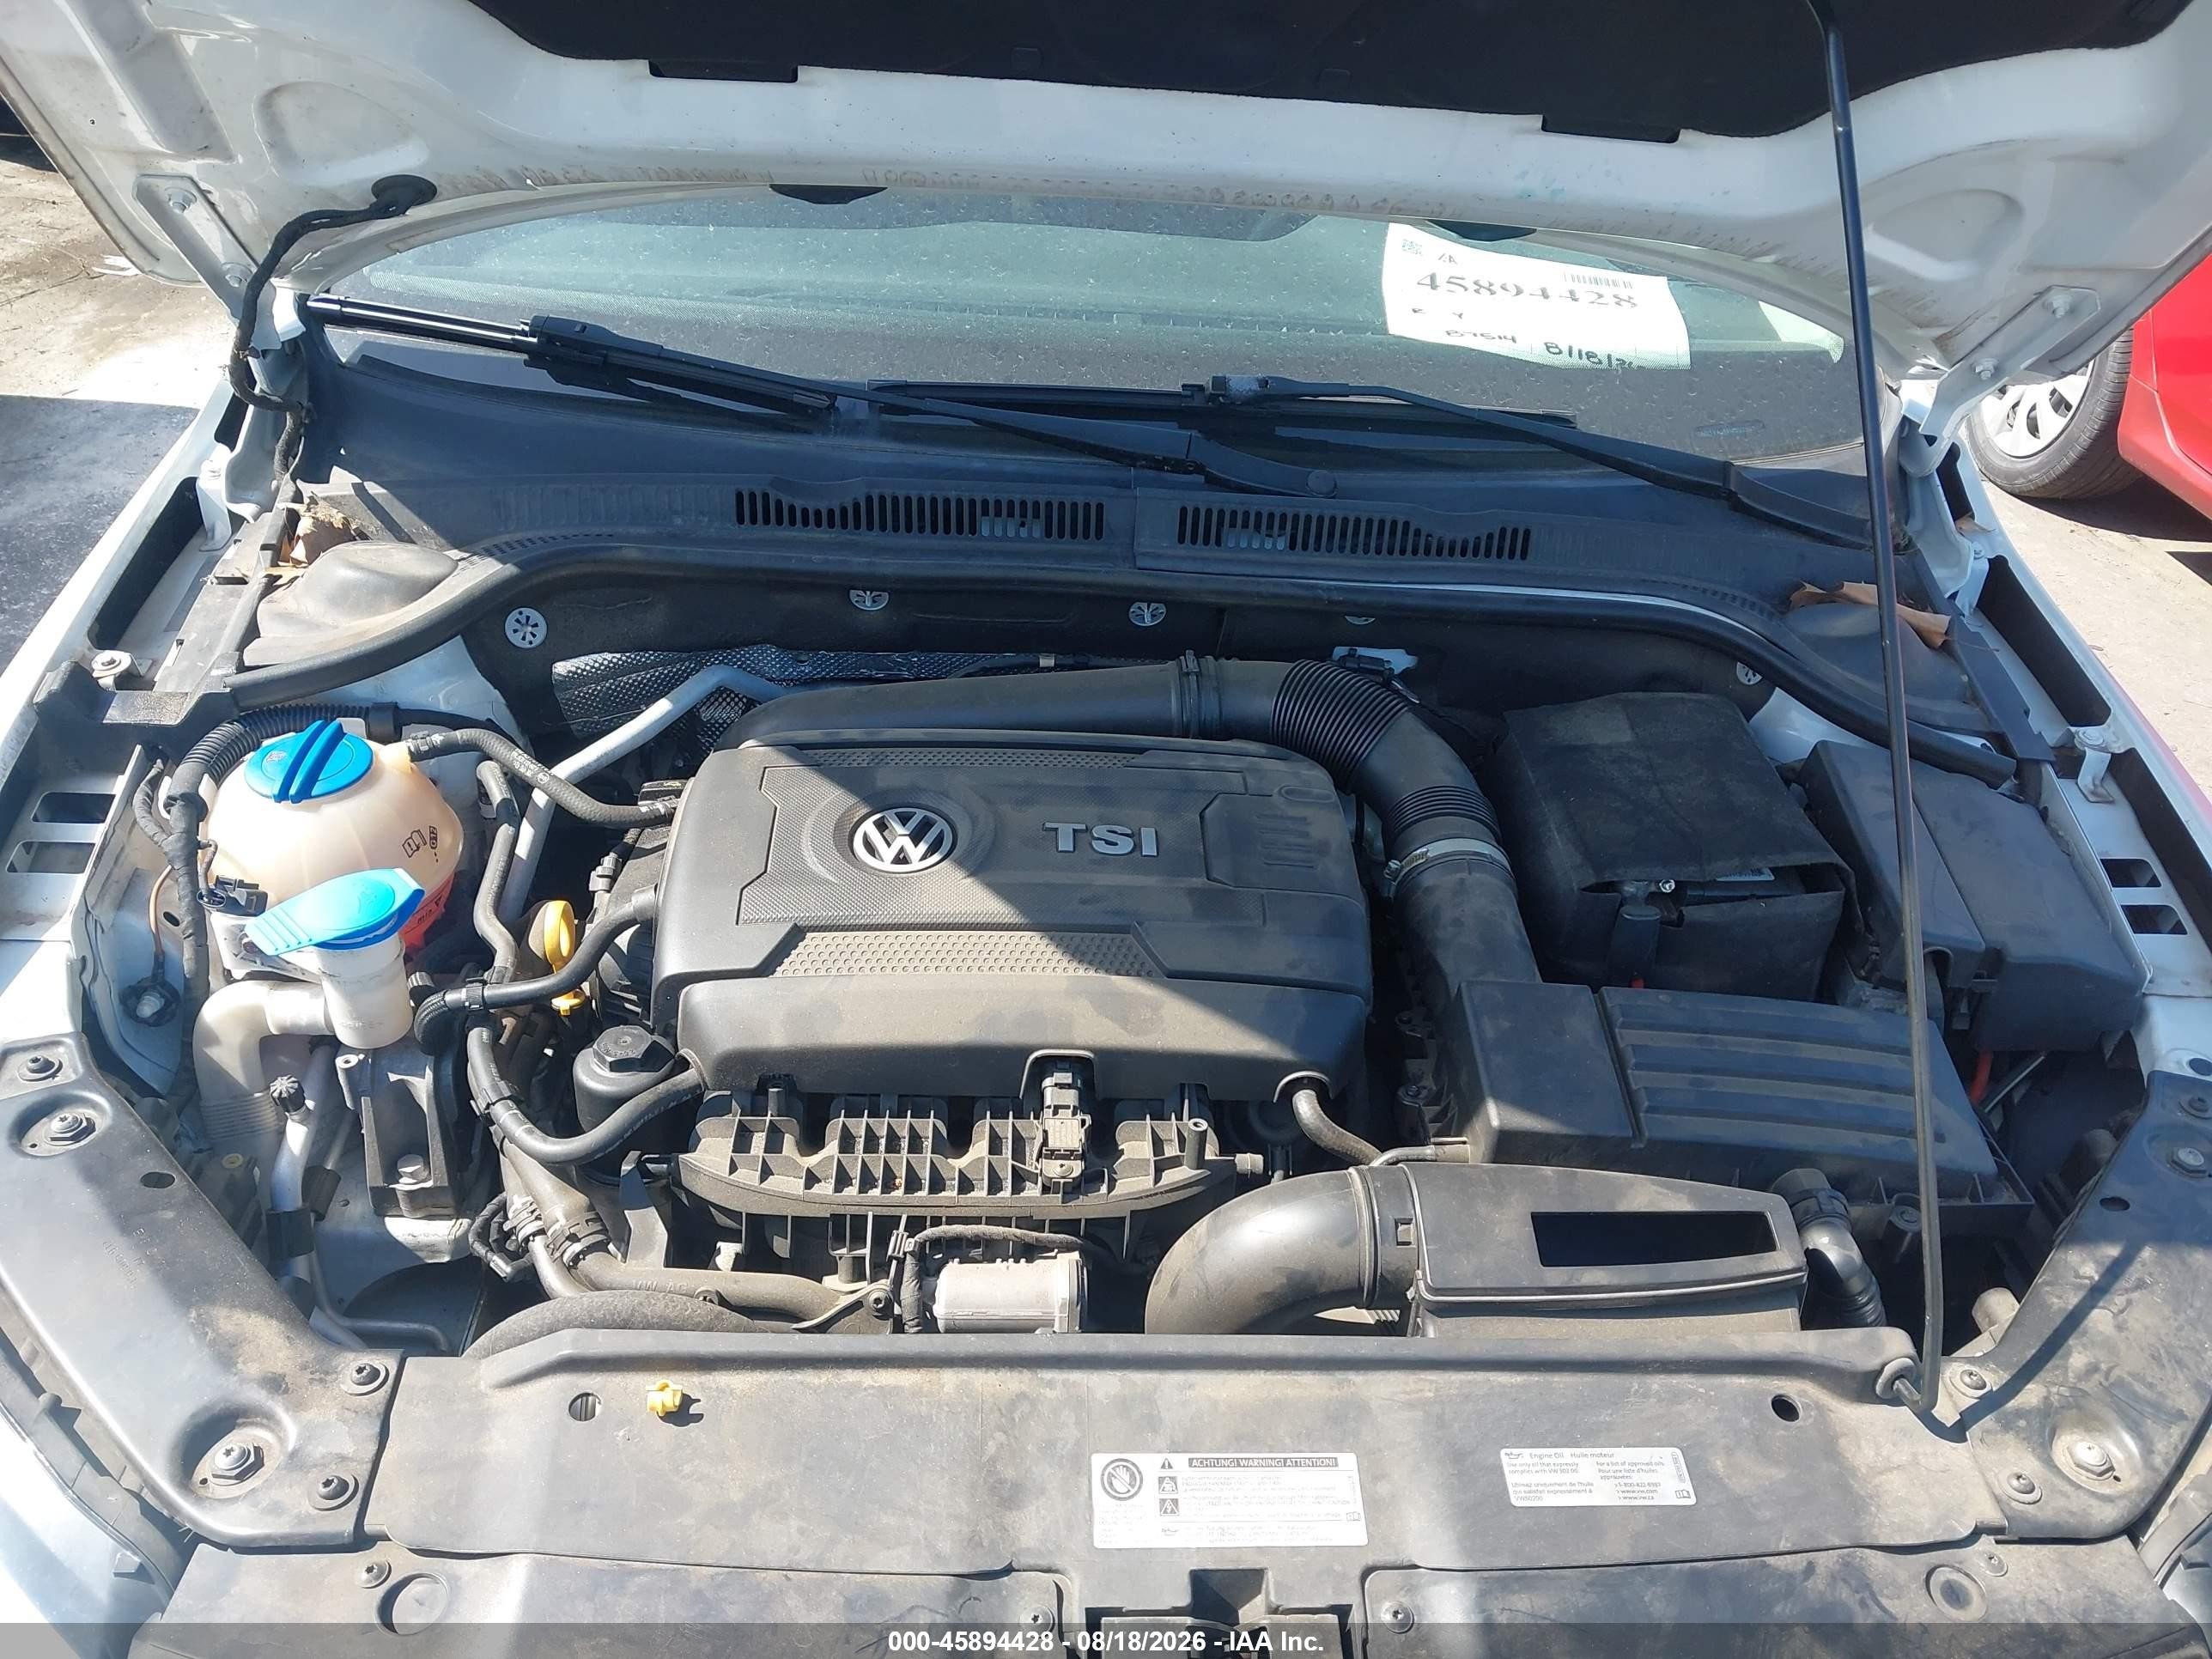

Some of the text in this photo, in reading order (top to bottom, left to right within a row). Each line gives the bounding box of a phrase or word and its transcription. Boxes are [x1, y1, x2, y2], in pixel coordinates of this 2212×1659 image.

[1416, 271, 1638, 308] 45894428
[1042, 821, 1159, 857] TSI
[1191, 1457, 1336, 1468] ACHTUNG! WARNING! ATTENTION!
